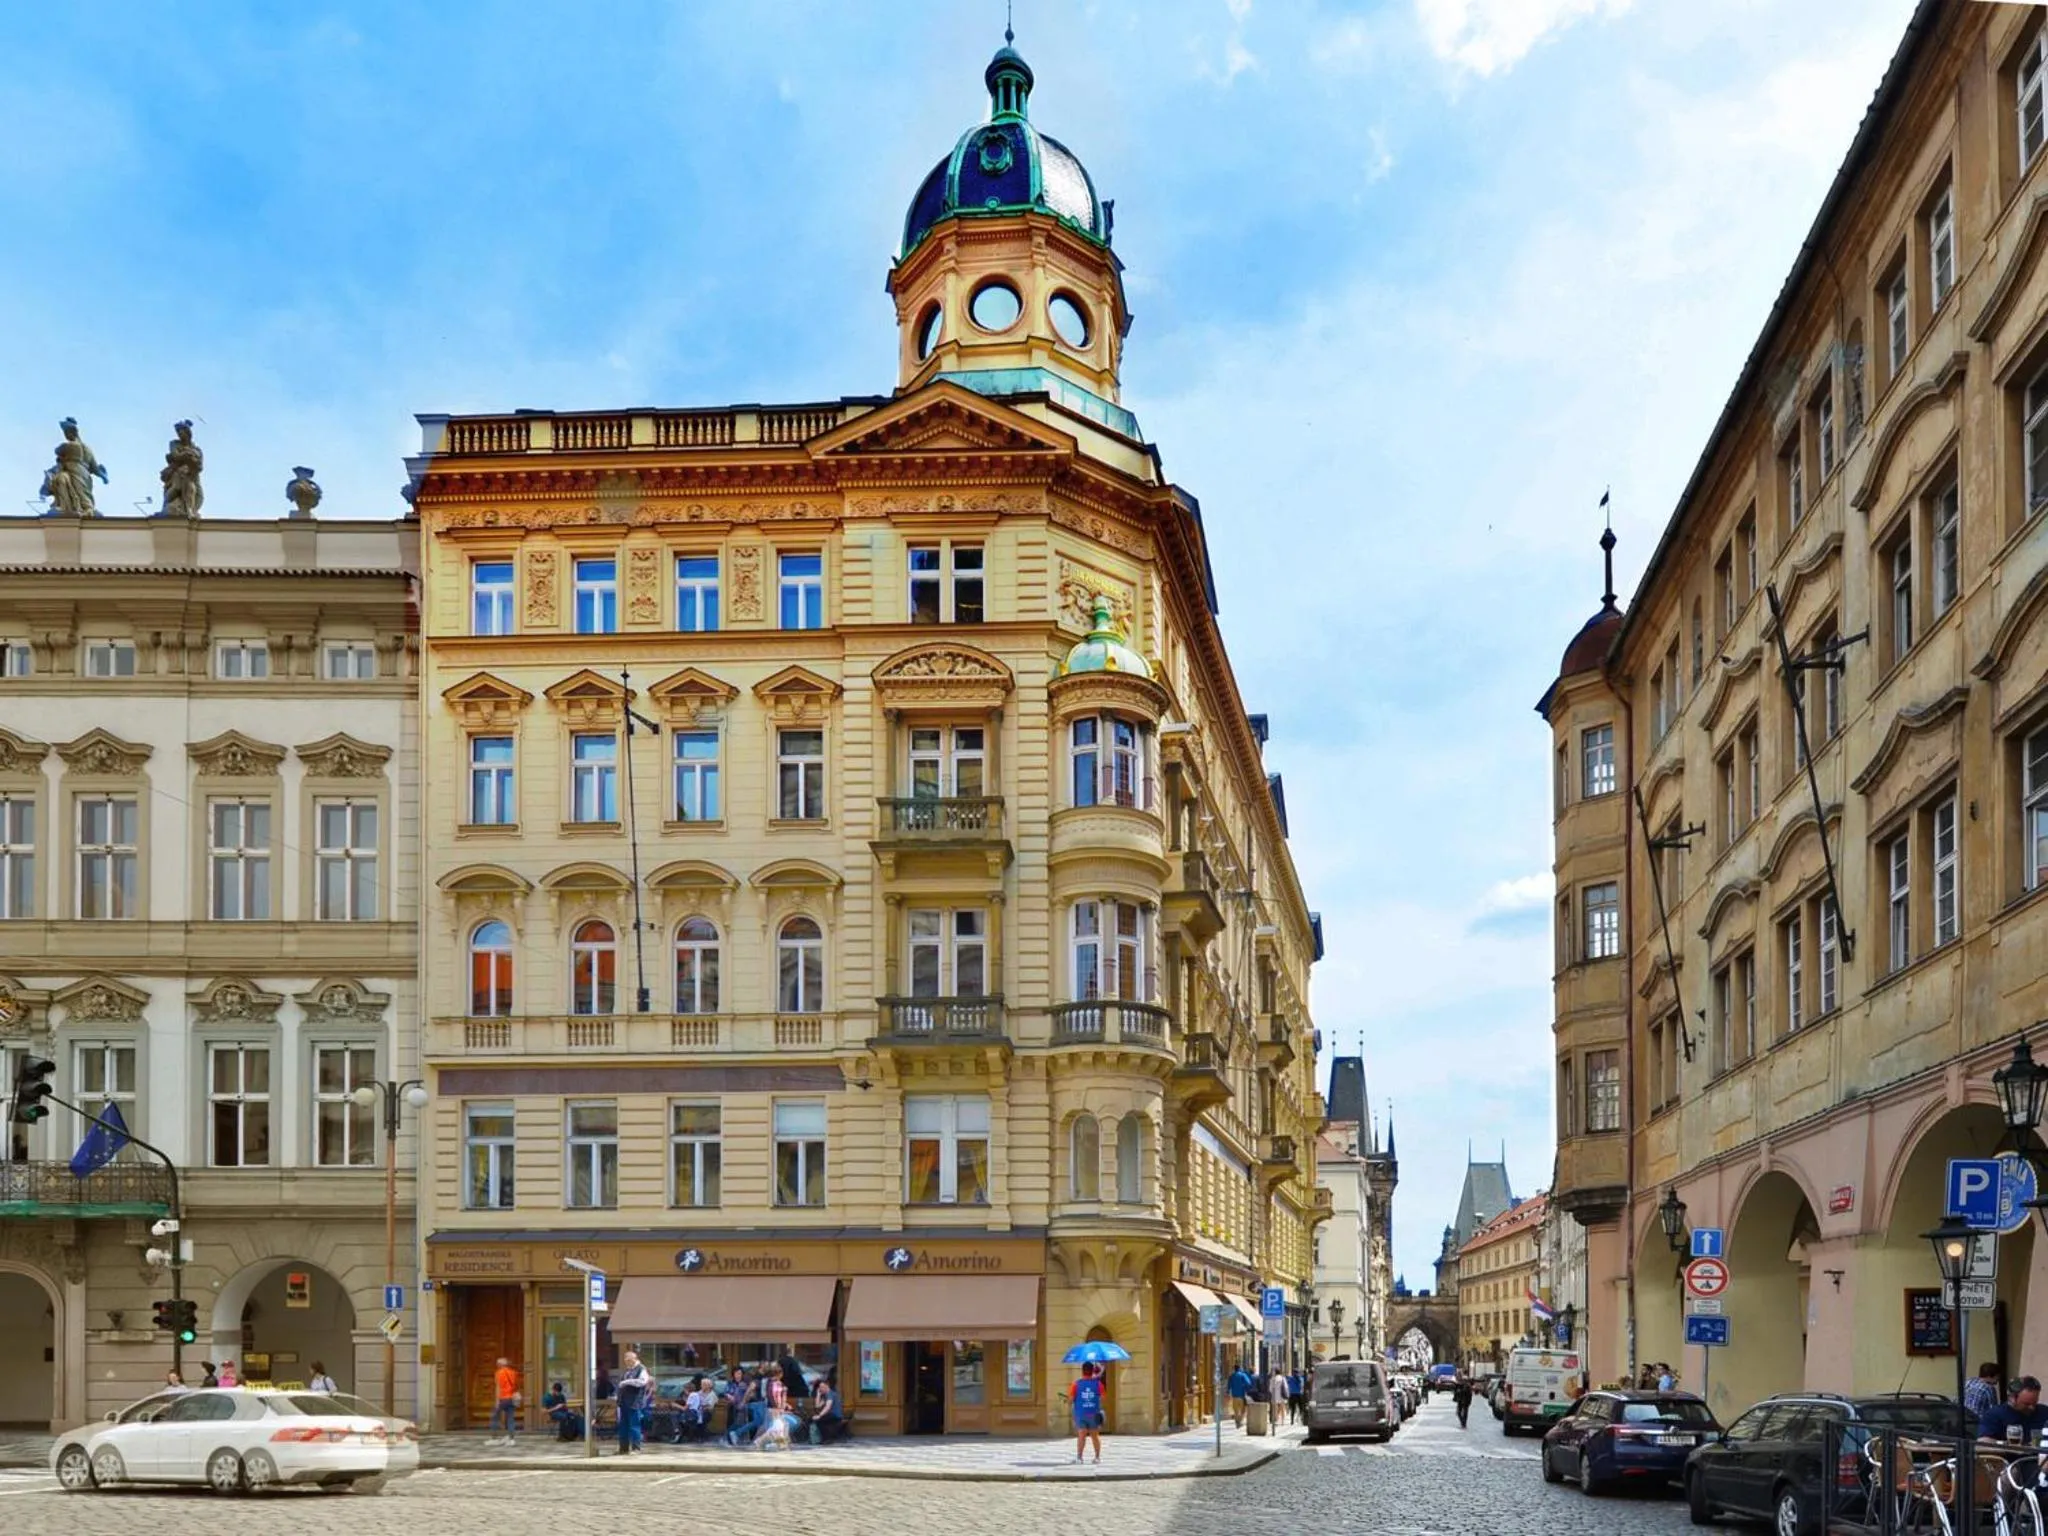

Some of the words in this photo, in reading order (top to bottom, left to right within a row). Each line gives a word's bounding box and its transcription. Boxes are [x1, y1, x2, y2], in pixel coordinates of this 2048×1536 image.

[1959, 1168, 1990, 1206] P
[444, 1262, 514, 1272] RESIDENCE
[704, 1252, 791, 1271] Amorino
[914, 1250, 1001, 1270] Amorino
[1954, 1296, 1985, 1305] OTOR
